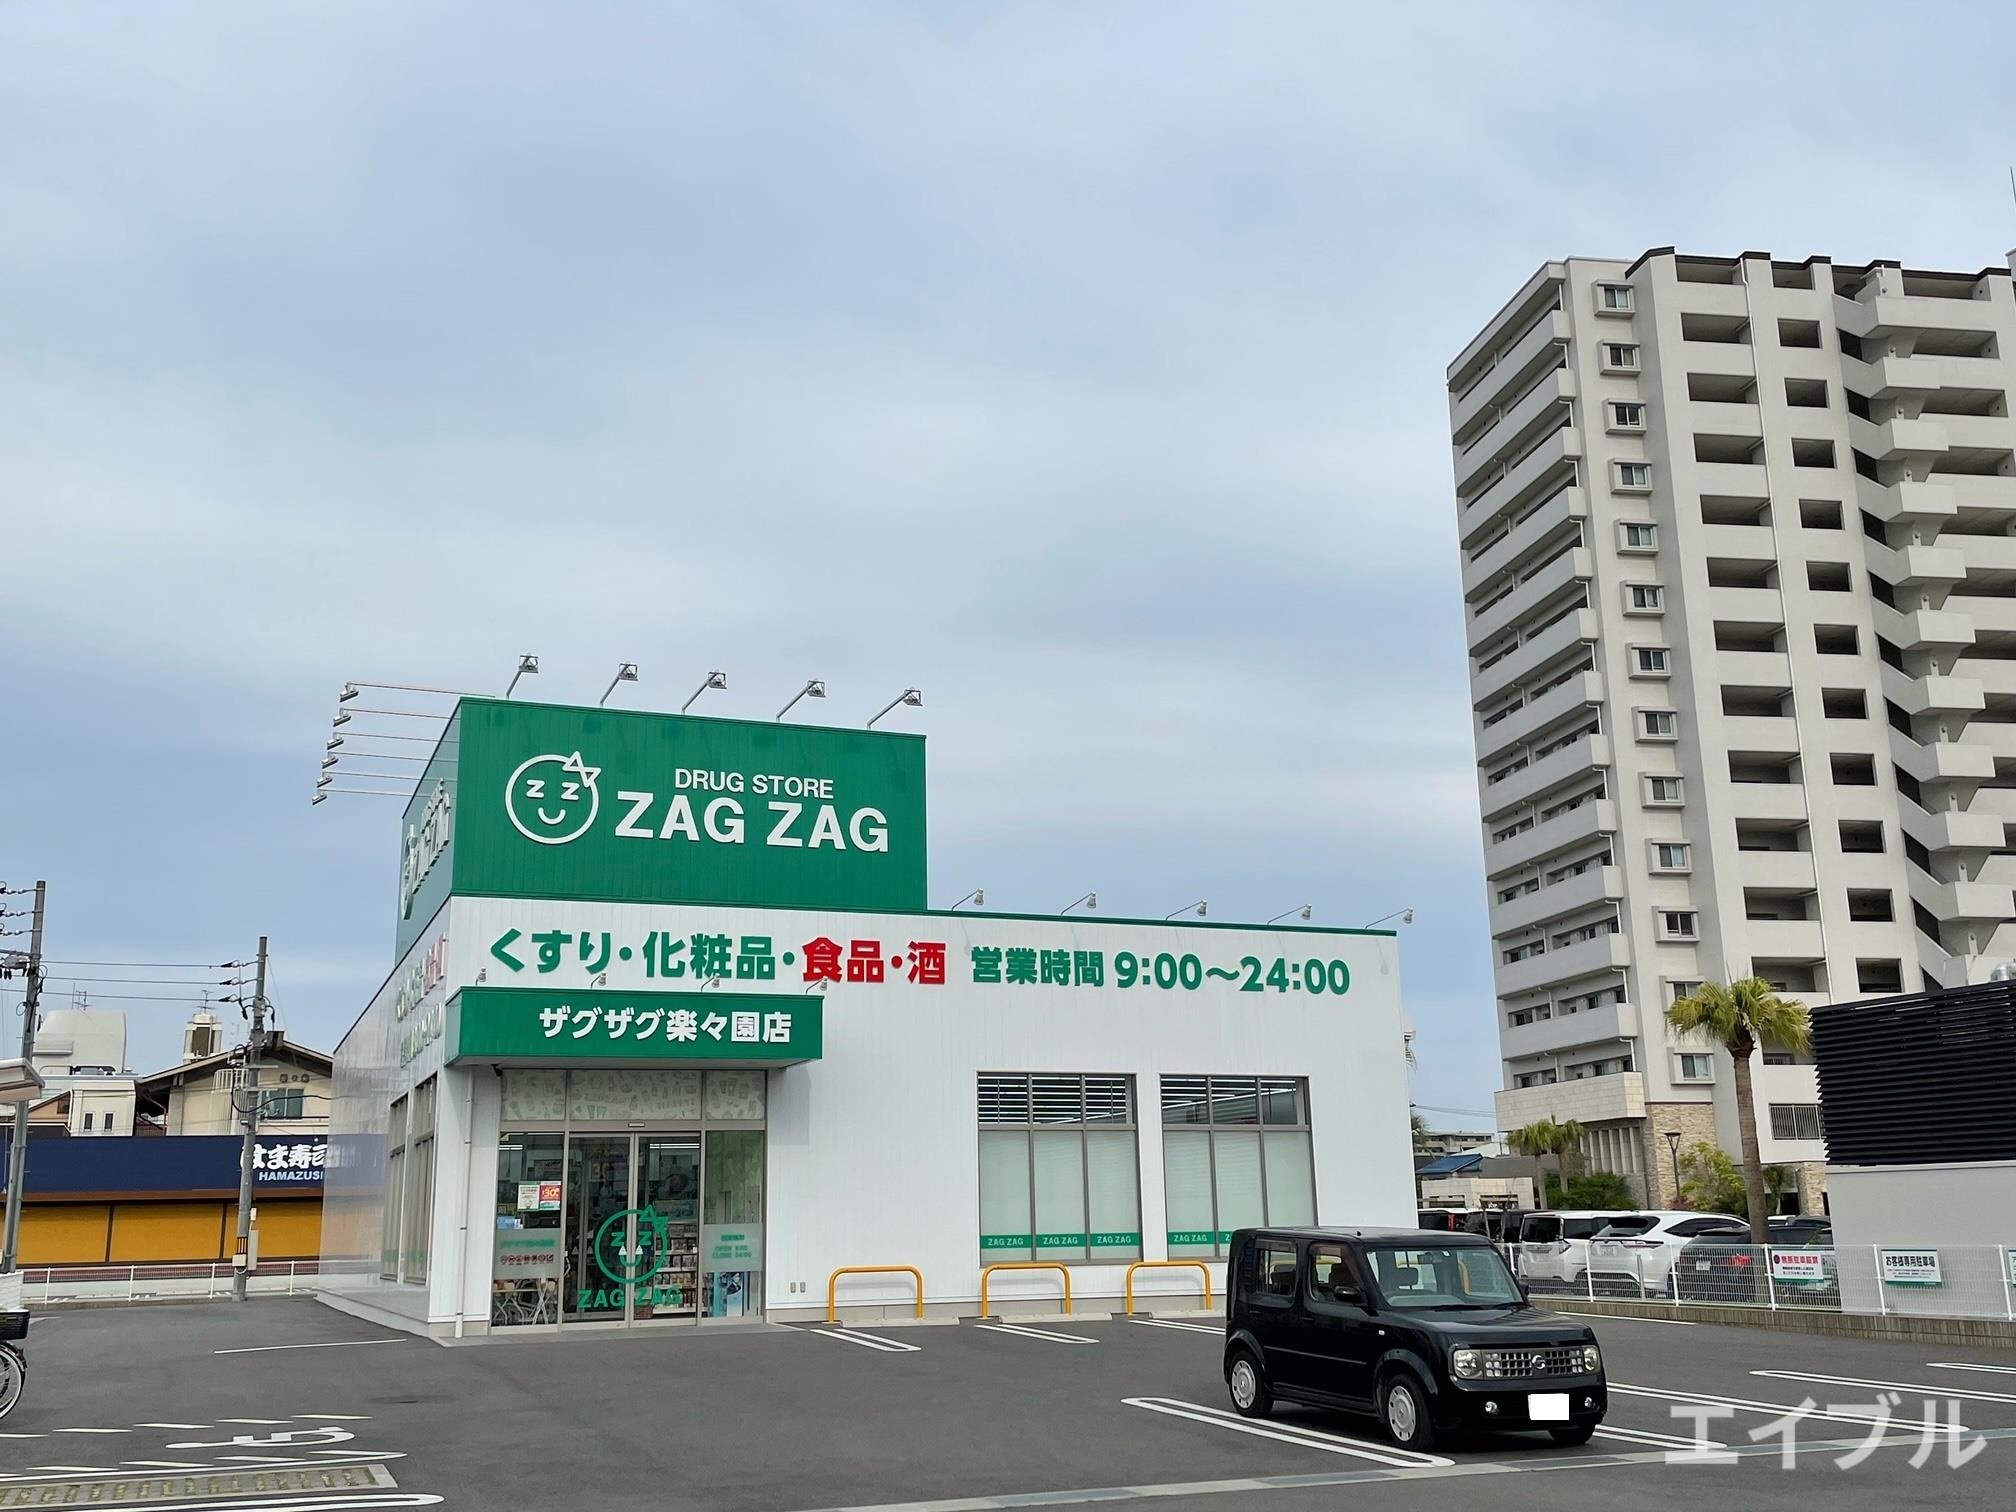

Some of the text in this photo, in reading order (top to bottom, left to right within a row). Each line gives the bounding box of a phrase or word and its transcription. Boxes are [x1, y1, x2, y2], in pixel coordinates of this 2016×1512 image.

[675, 768, 834, 799] DRUG STORE
[615, 790, 889, 853] ZAG ZAG
[971, 946, 1104, 987] 営業時間
[539, 1005, 792, 1043] ザグザグ楽々園店
[258, 1171, 324, 1181] HAMAZUS
[988, 1238, 1024, 1246] ZAG ZAG
[1043, 1236, 1079, 1245] ZAG ZAG
[1097, 1235, 1132, 1244] ZAG ZAG
[1173, 1234, 1208, 1243] ZAG ZAG
[577, 1284, 683, 1309] ZAG ZAG
